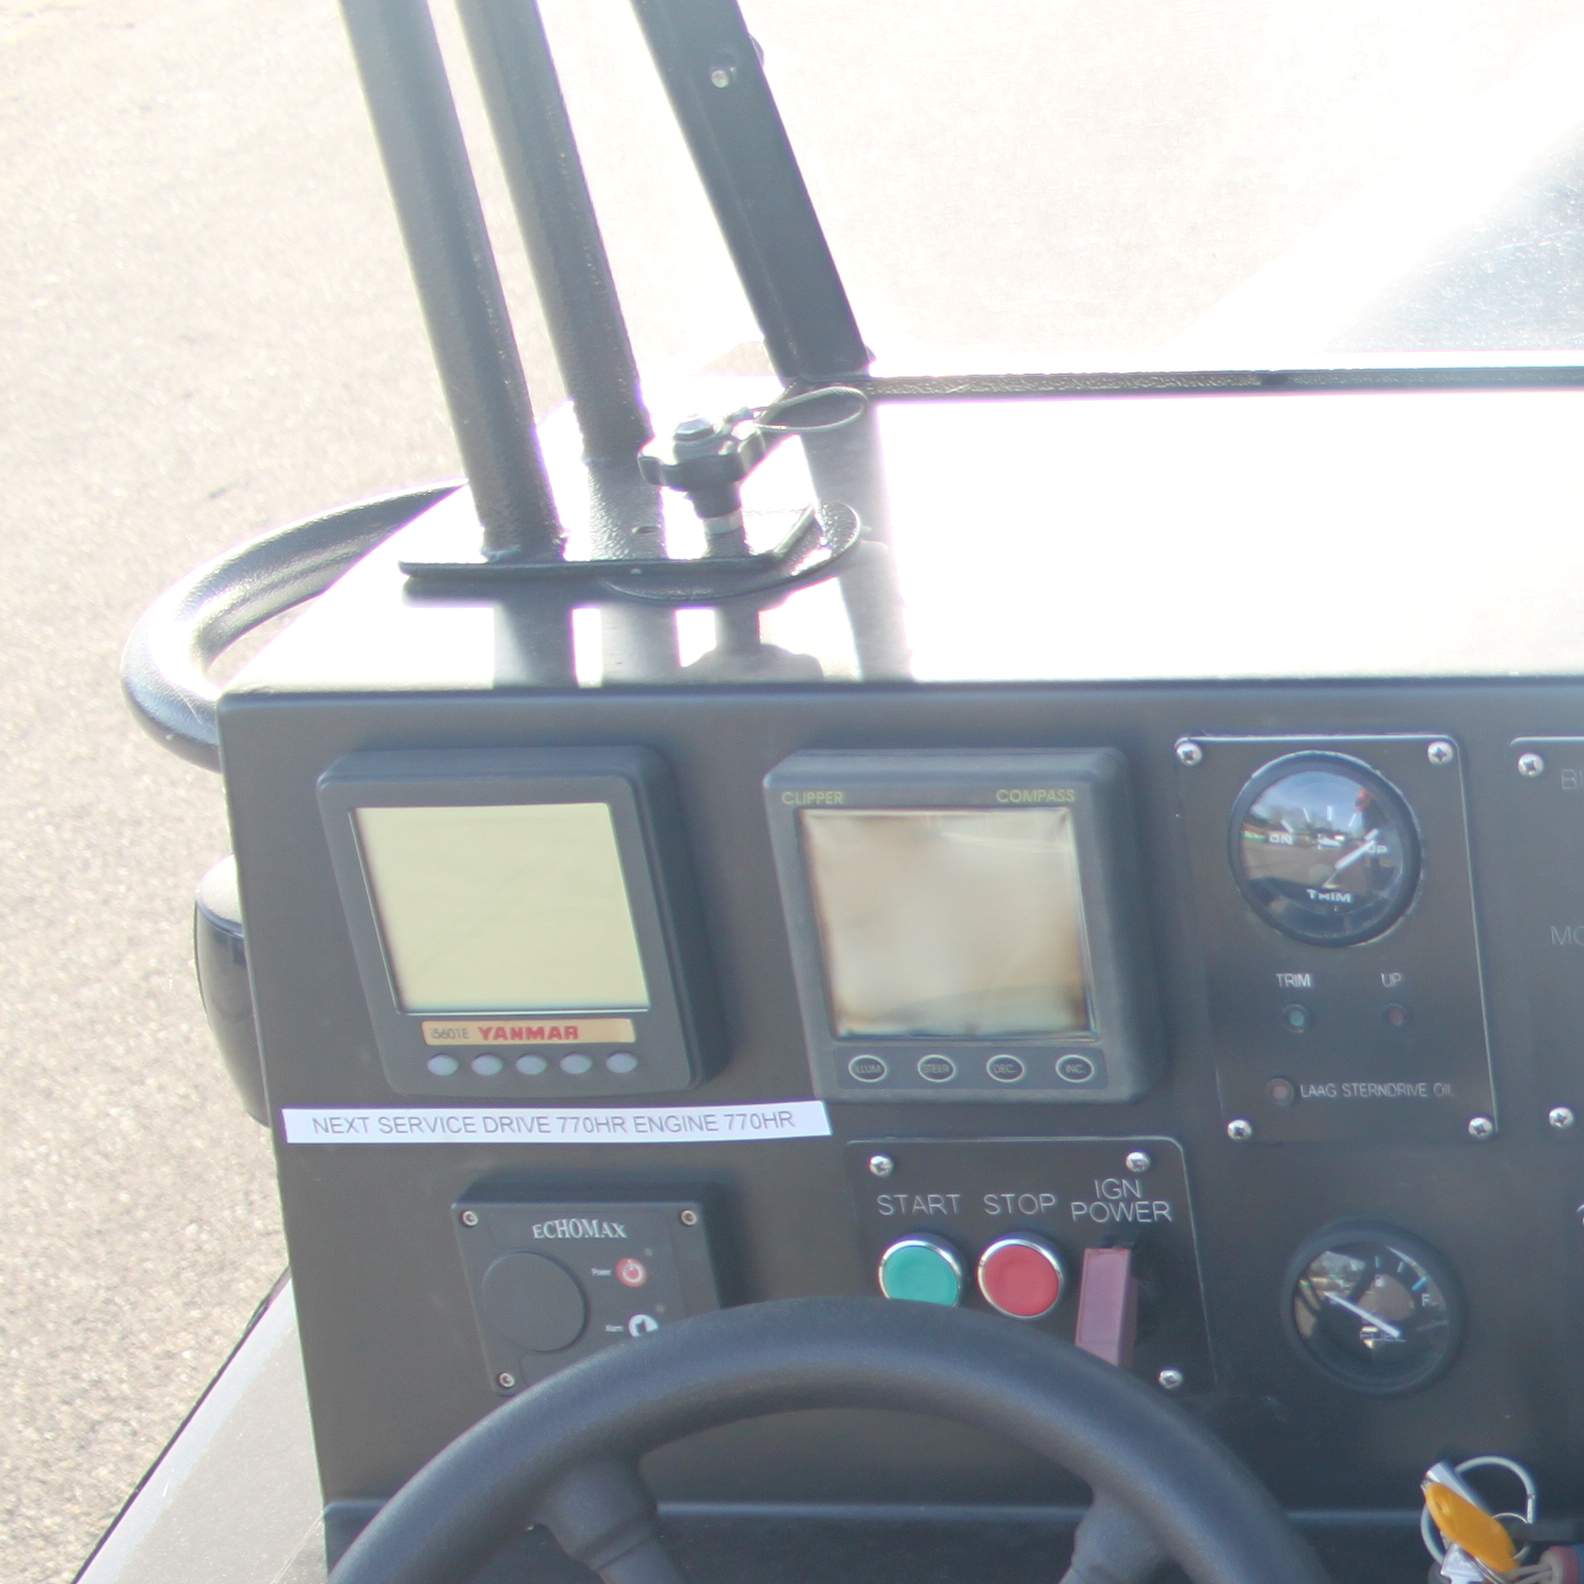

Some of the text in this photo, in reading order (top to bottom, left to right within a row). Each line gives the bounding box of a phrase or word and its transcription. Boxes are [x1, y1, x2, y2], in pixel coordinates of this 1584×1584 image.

[782, 790, 844, 805] CLIPPER
[996, 788, 1075, 803] COMPASS
[1307, 888, 1355, 905] TRIM
[1275, 972, 1311, 988] TRIM
[1380, 972, 1403, 988] UP
[478, 1025, 579, 1041] YANMAR
[1300, 1083, 1454, 1098] LAAG STERNDRIVE OIL
[313, 1110, 796, 1136] NEXT SERVICE DRIVE 770HR ENGINE 770HR
[1095, 1178, 1142, 1199] IGN
[877, 1194, 960, 1216] START
[983, 1193, 1056, 1215] STOP
[1071, 1200, 1172, 1222] POWER
[532, 1218, 627, 1239] ECHOMAX
